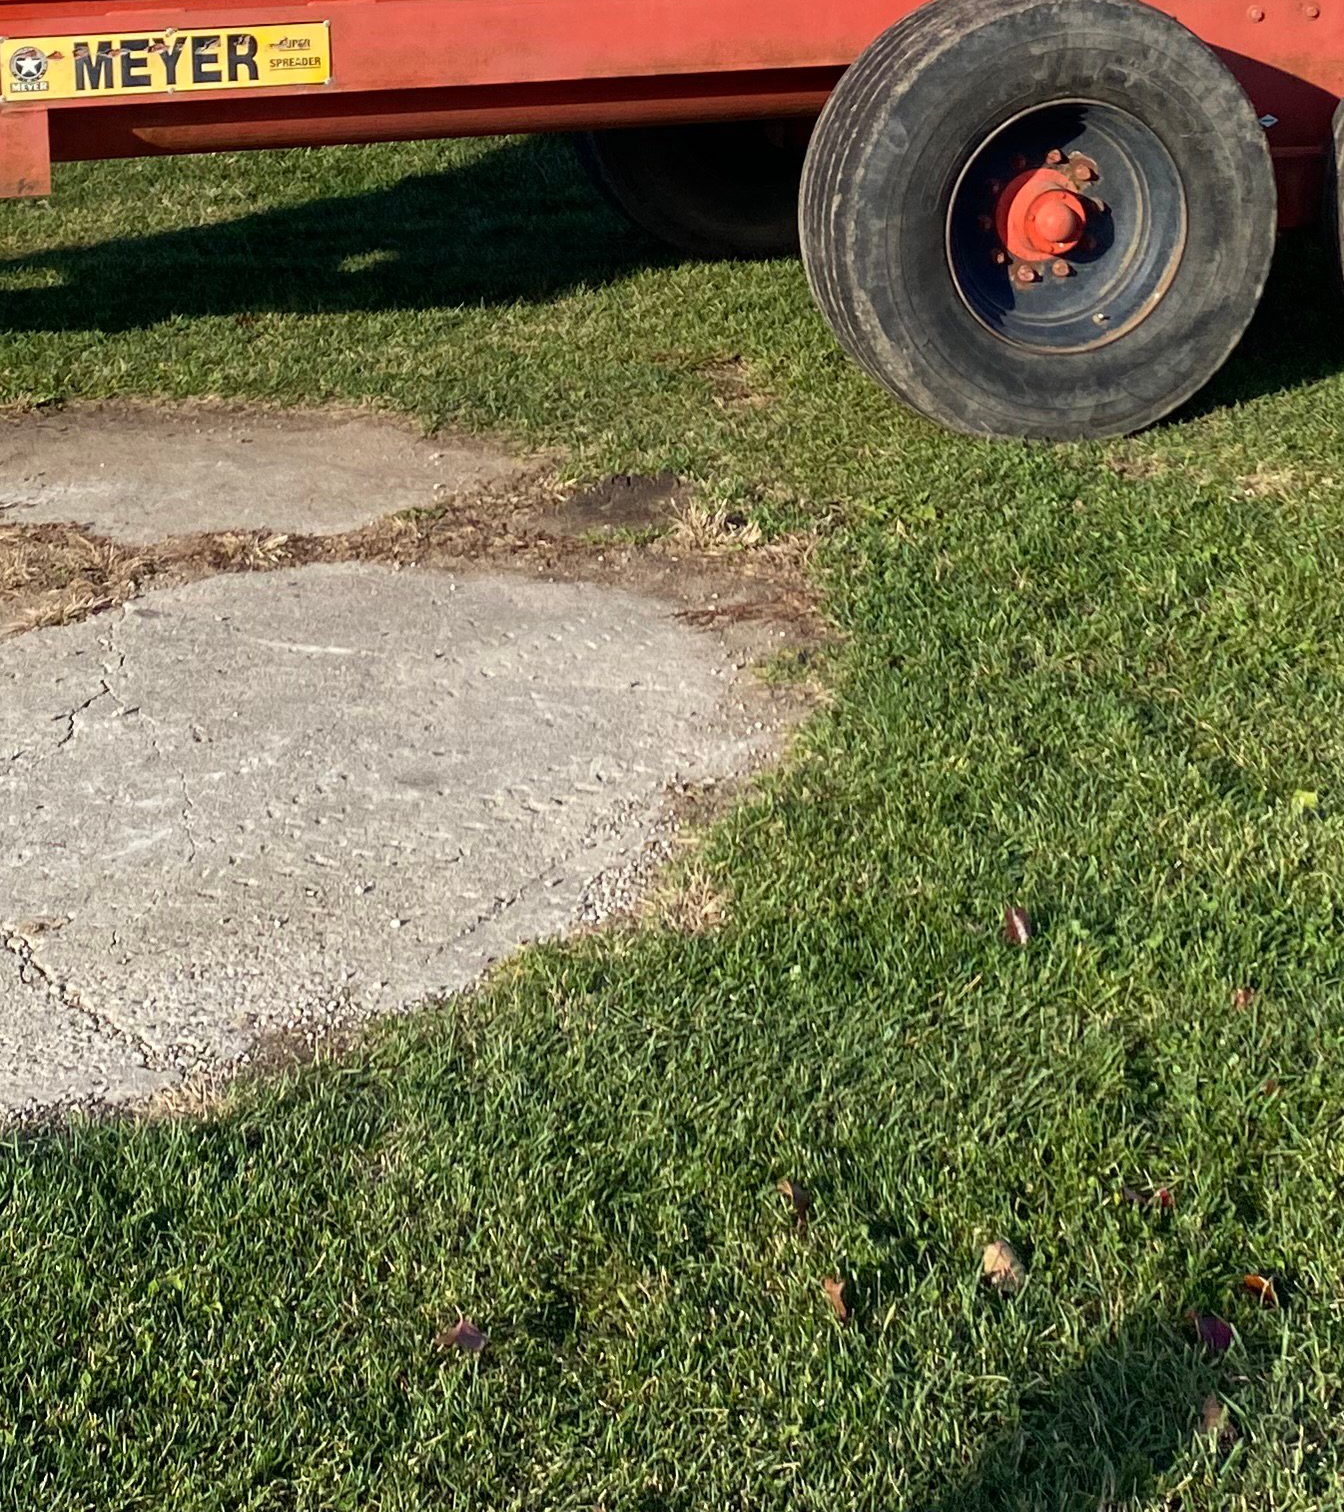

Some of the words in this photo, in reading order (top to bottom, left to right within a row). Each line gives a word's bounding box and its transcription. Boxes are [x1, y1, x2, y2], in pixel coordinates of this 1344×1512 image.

[72, 33, 260, 91] MEYER
[269, 56, 322, 68] SPREADER
[10, 81, 49, 93] MEYER
